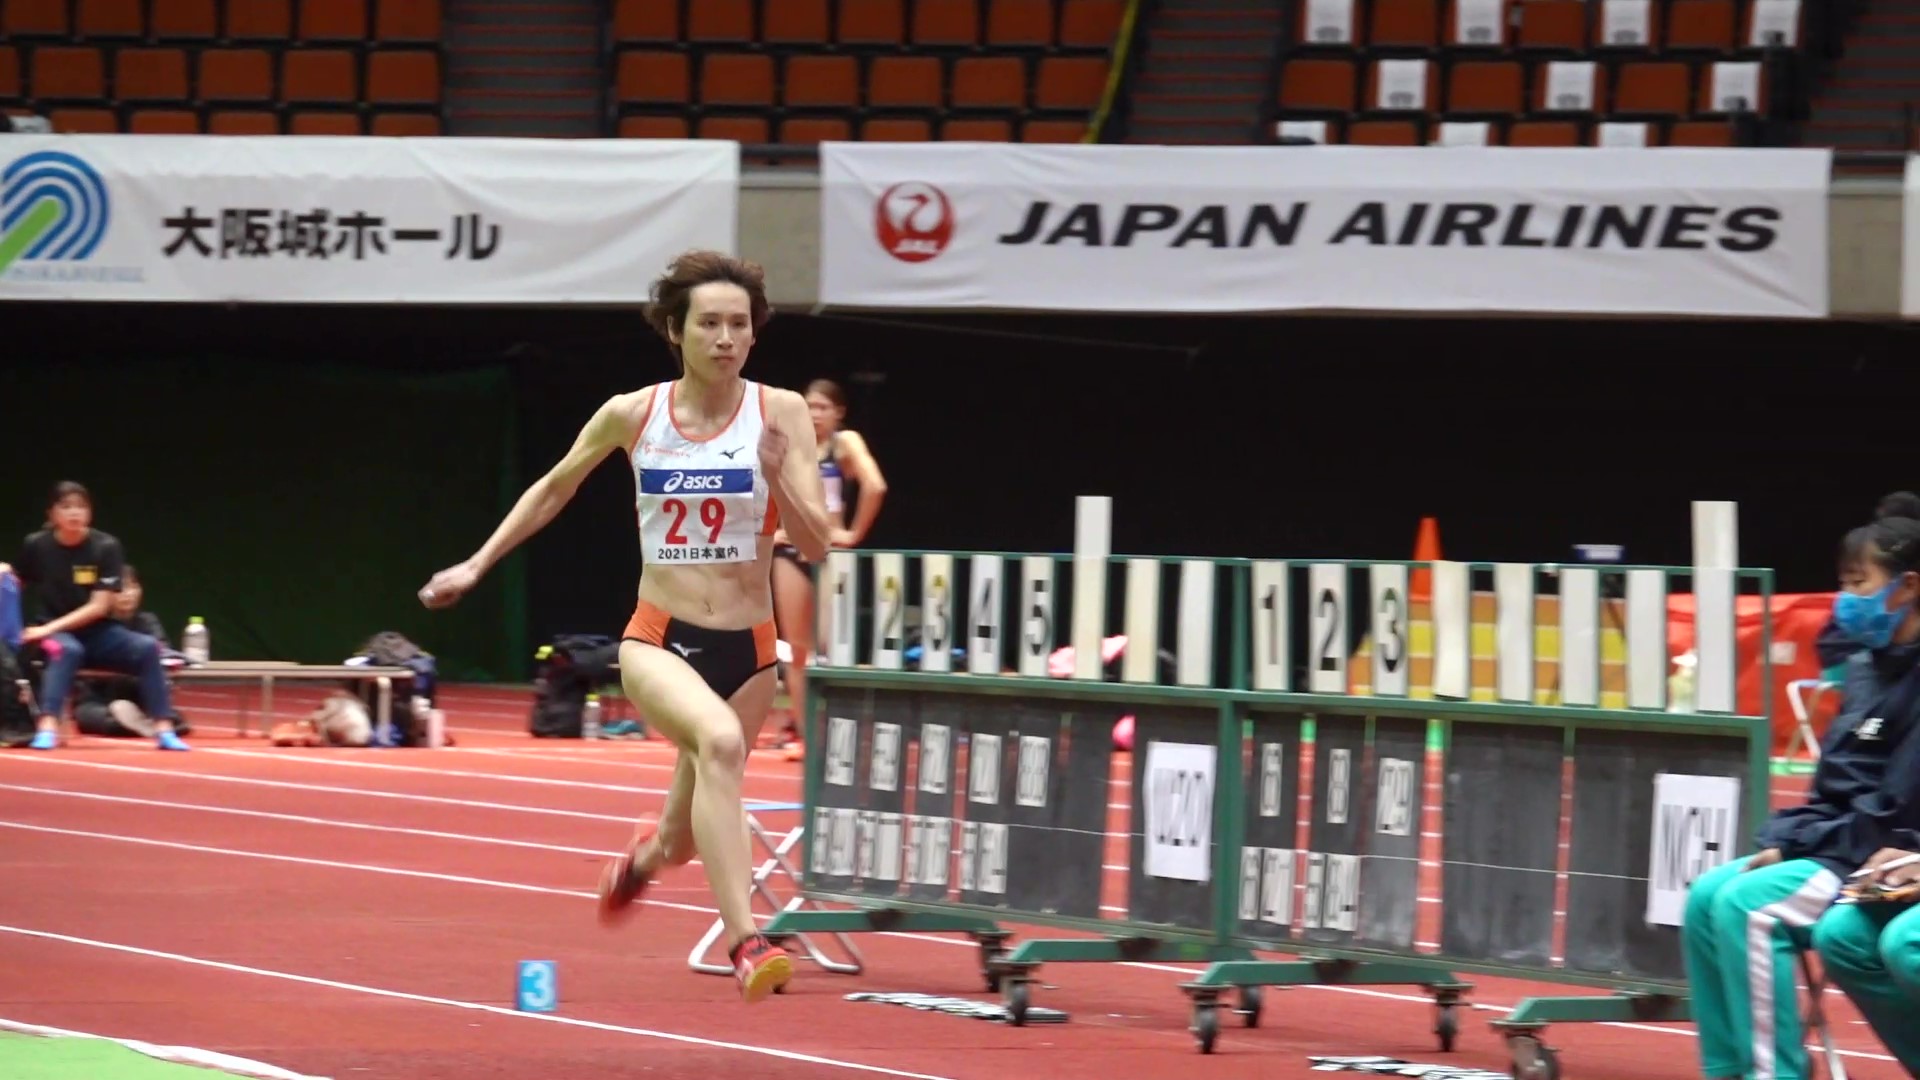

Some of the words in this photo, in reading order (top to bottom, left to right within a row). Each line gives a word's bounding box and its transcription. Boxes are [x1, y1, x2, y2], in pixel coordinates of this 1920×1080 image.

[162, 208, 502, 260] 大阪城ホール
[997, 201, 1309, 248] JAPAN
[1327, 201, 1782, 252] AIRLINES
[683, 474, 723, 490] asics
[662, 497, 726, 545] 29
[833, 571, 849, 645] 1
[877, 575, 901, 650] 2
[925, 575, 949, 650] 3
[971, 578, 997, 653] 4
[1024, 579, 1050, 656] 5
[1260, 584, 1279, 665] 1
[1318, 588, 1342, 671] 2
[1377, 587, 1406, 672] 3
[521, 962, 555, 1008] 3
